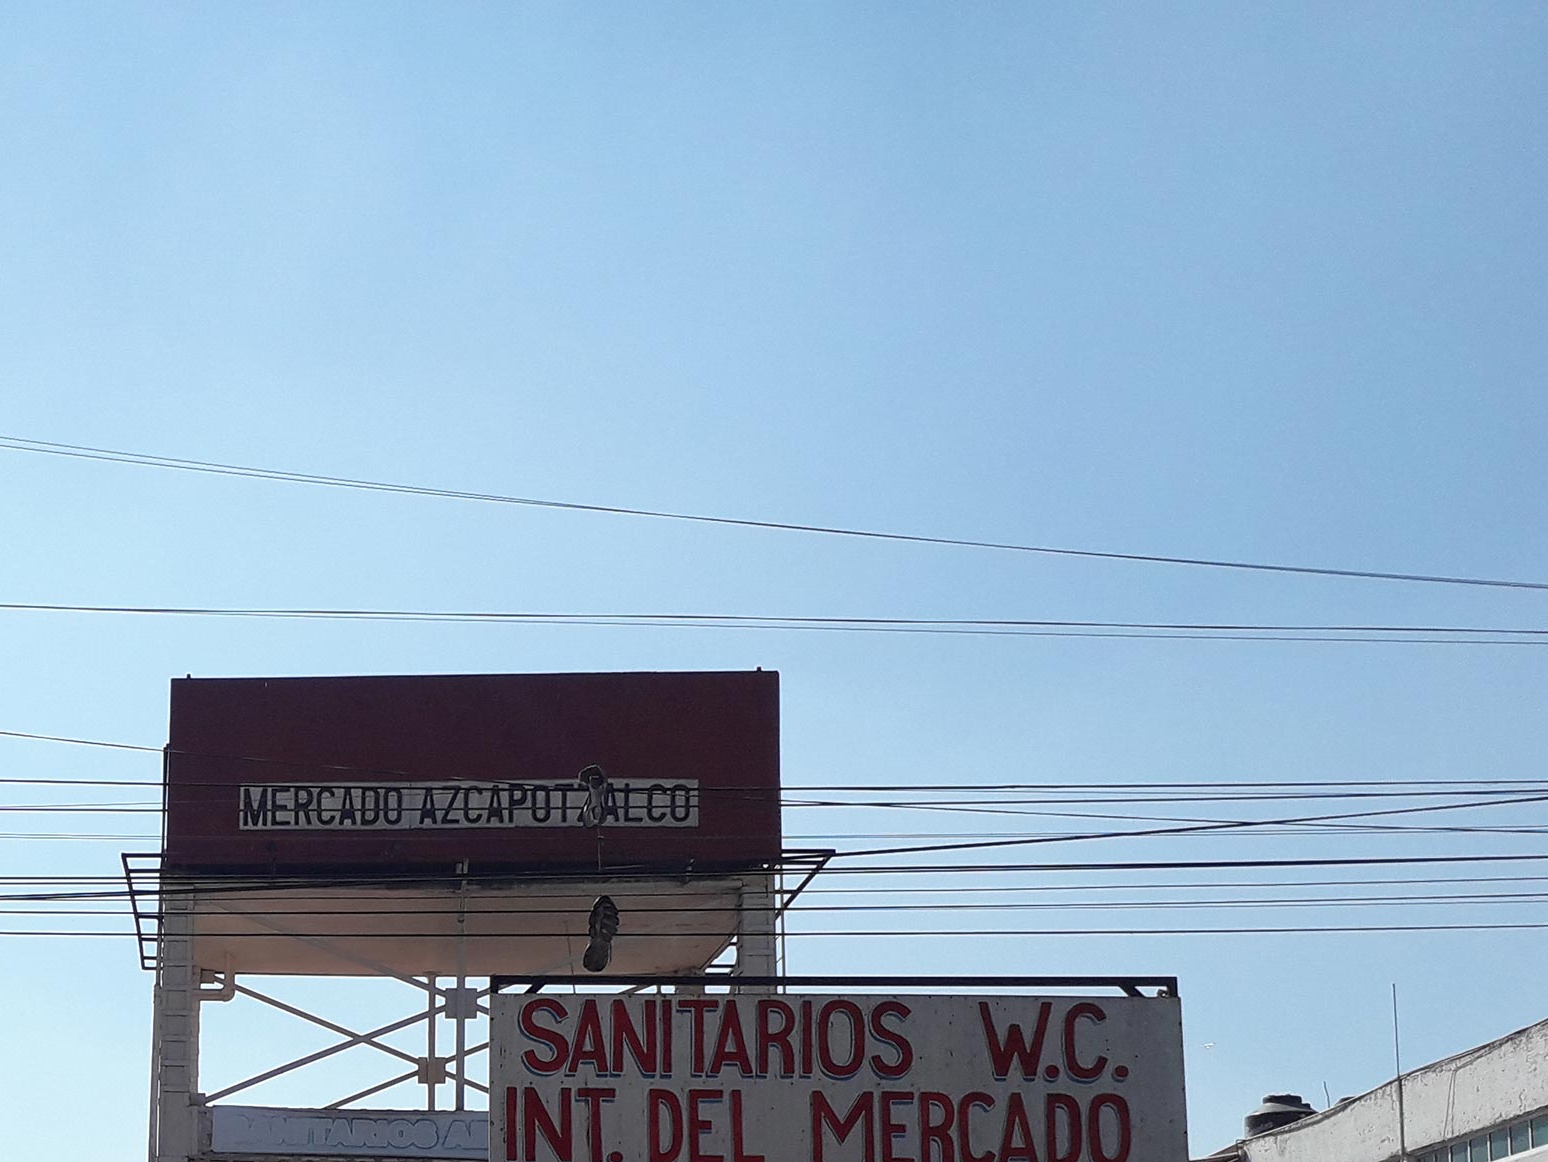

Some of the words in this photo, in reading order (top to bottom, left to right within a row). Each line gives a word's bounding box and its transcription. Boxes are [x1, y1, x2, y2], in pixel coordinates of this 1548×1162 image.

[242, 787, 402, 826] MERCADO
[519, 998, 914, 1079] SANITARIOS
[978, 1001, 1130, 1082] W.C.
